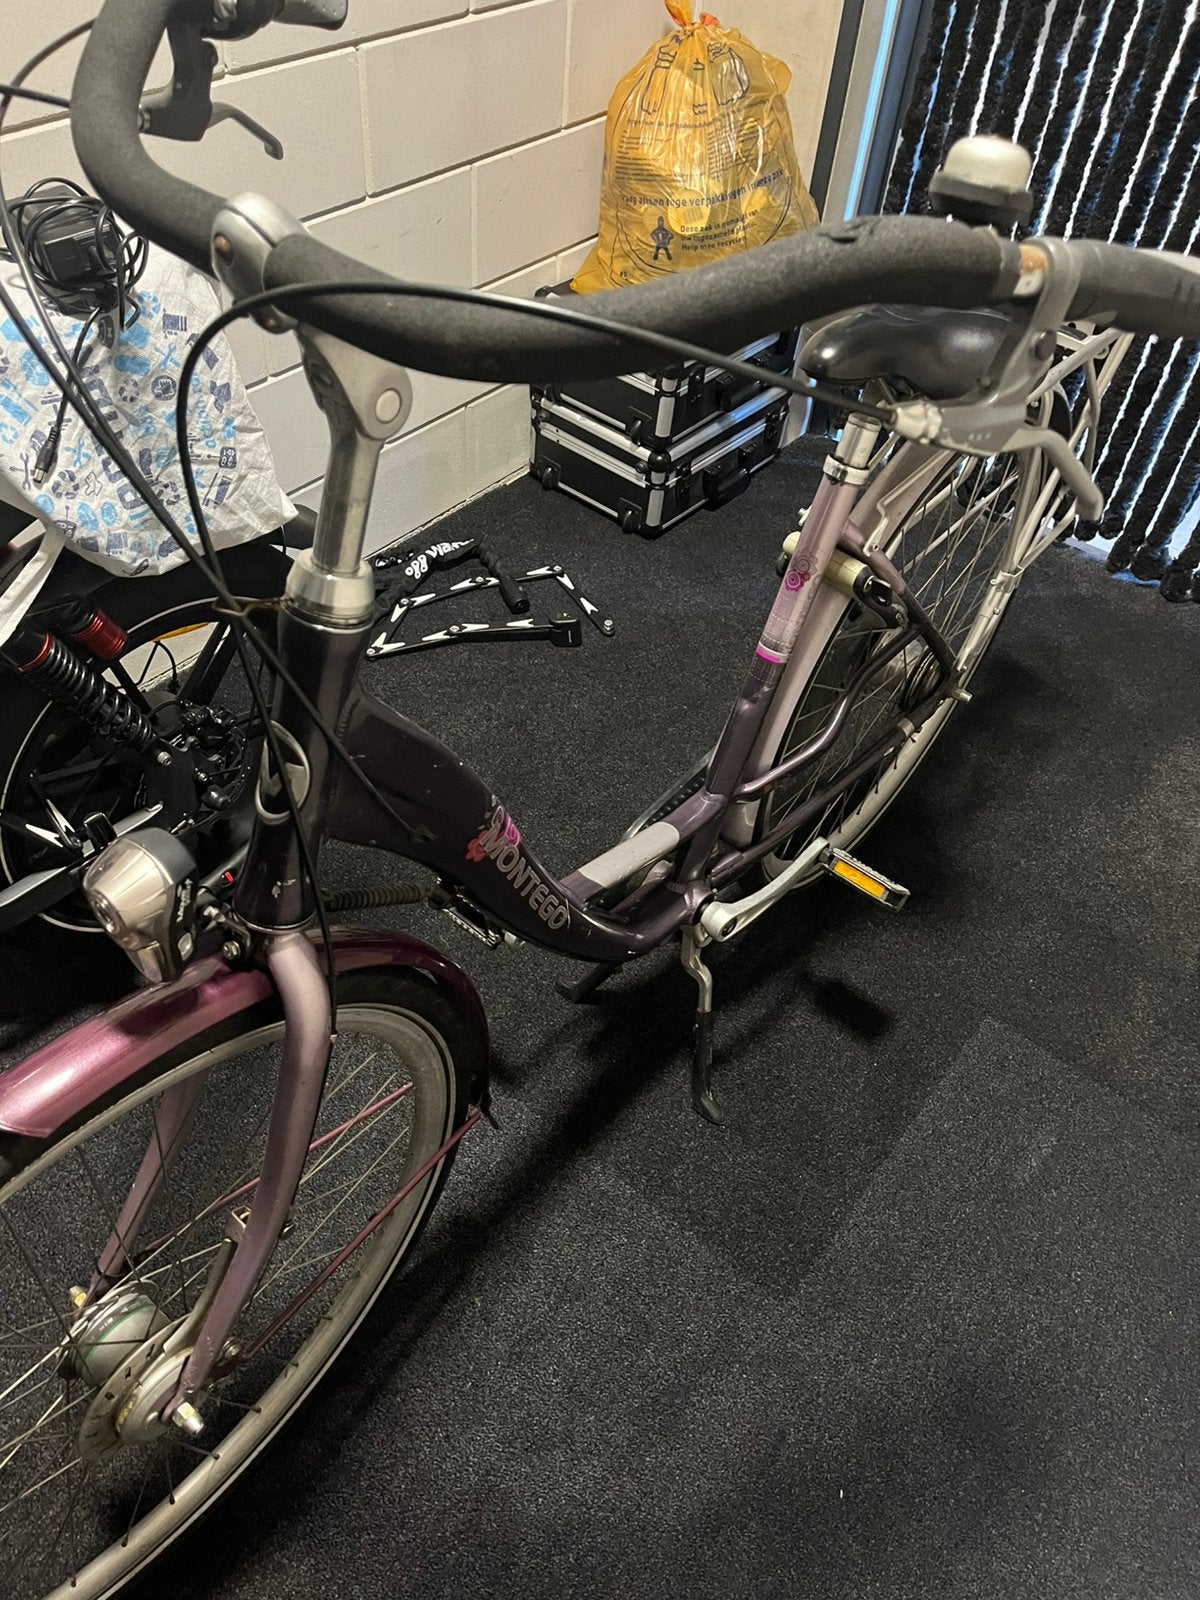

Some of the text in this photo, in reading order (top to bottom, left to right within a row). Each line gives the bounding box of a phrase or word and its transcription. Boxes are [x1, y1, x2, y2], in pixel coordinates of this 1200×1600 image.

[680, 225, 698, 233] Deze
[681, 243, 699, 252] Help
[478, 821, 568, 930] MONTEGO
